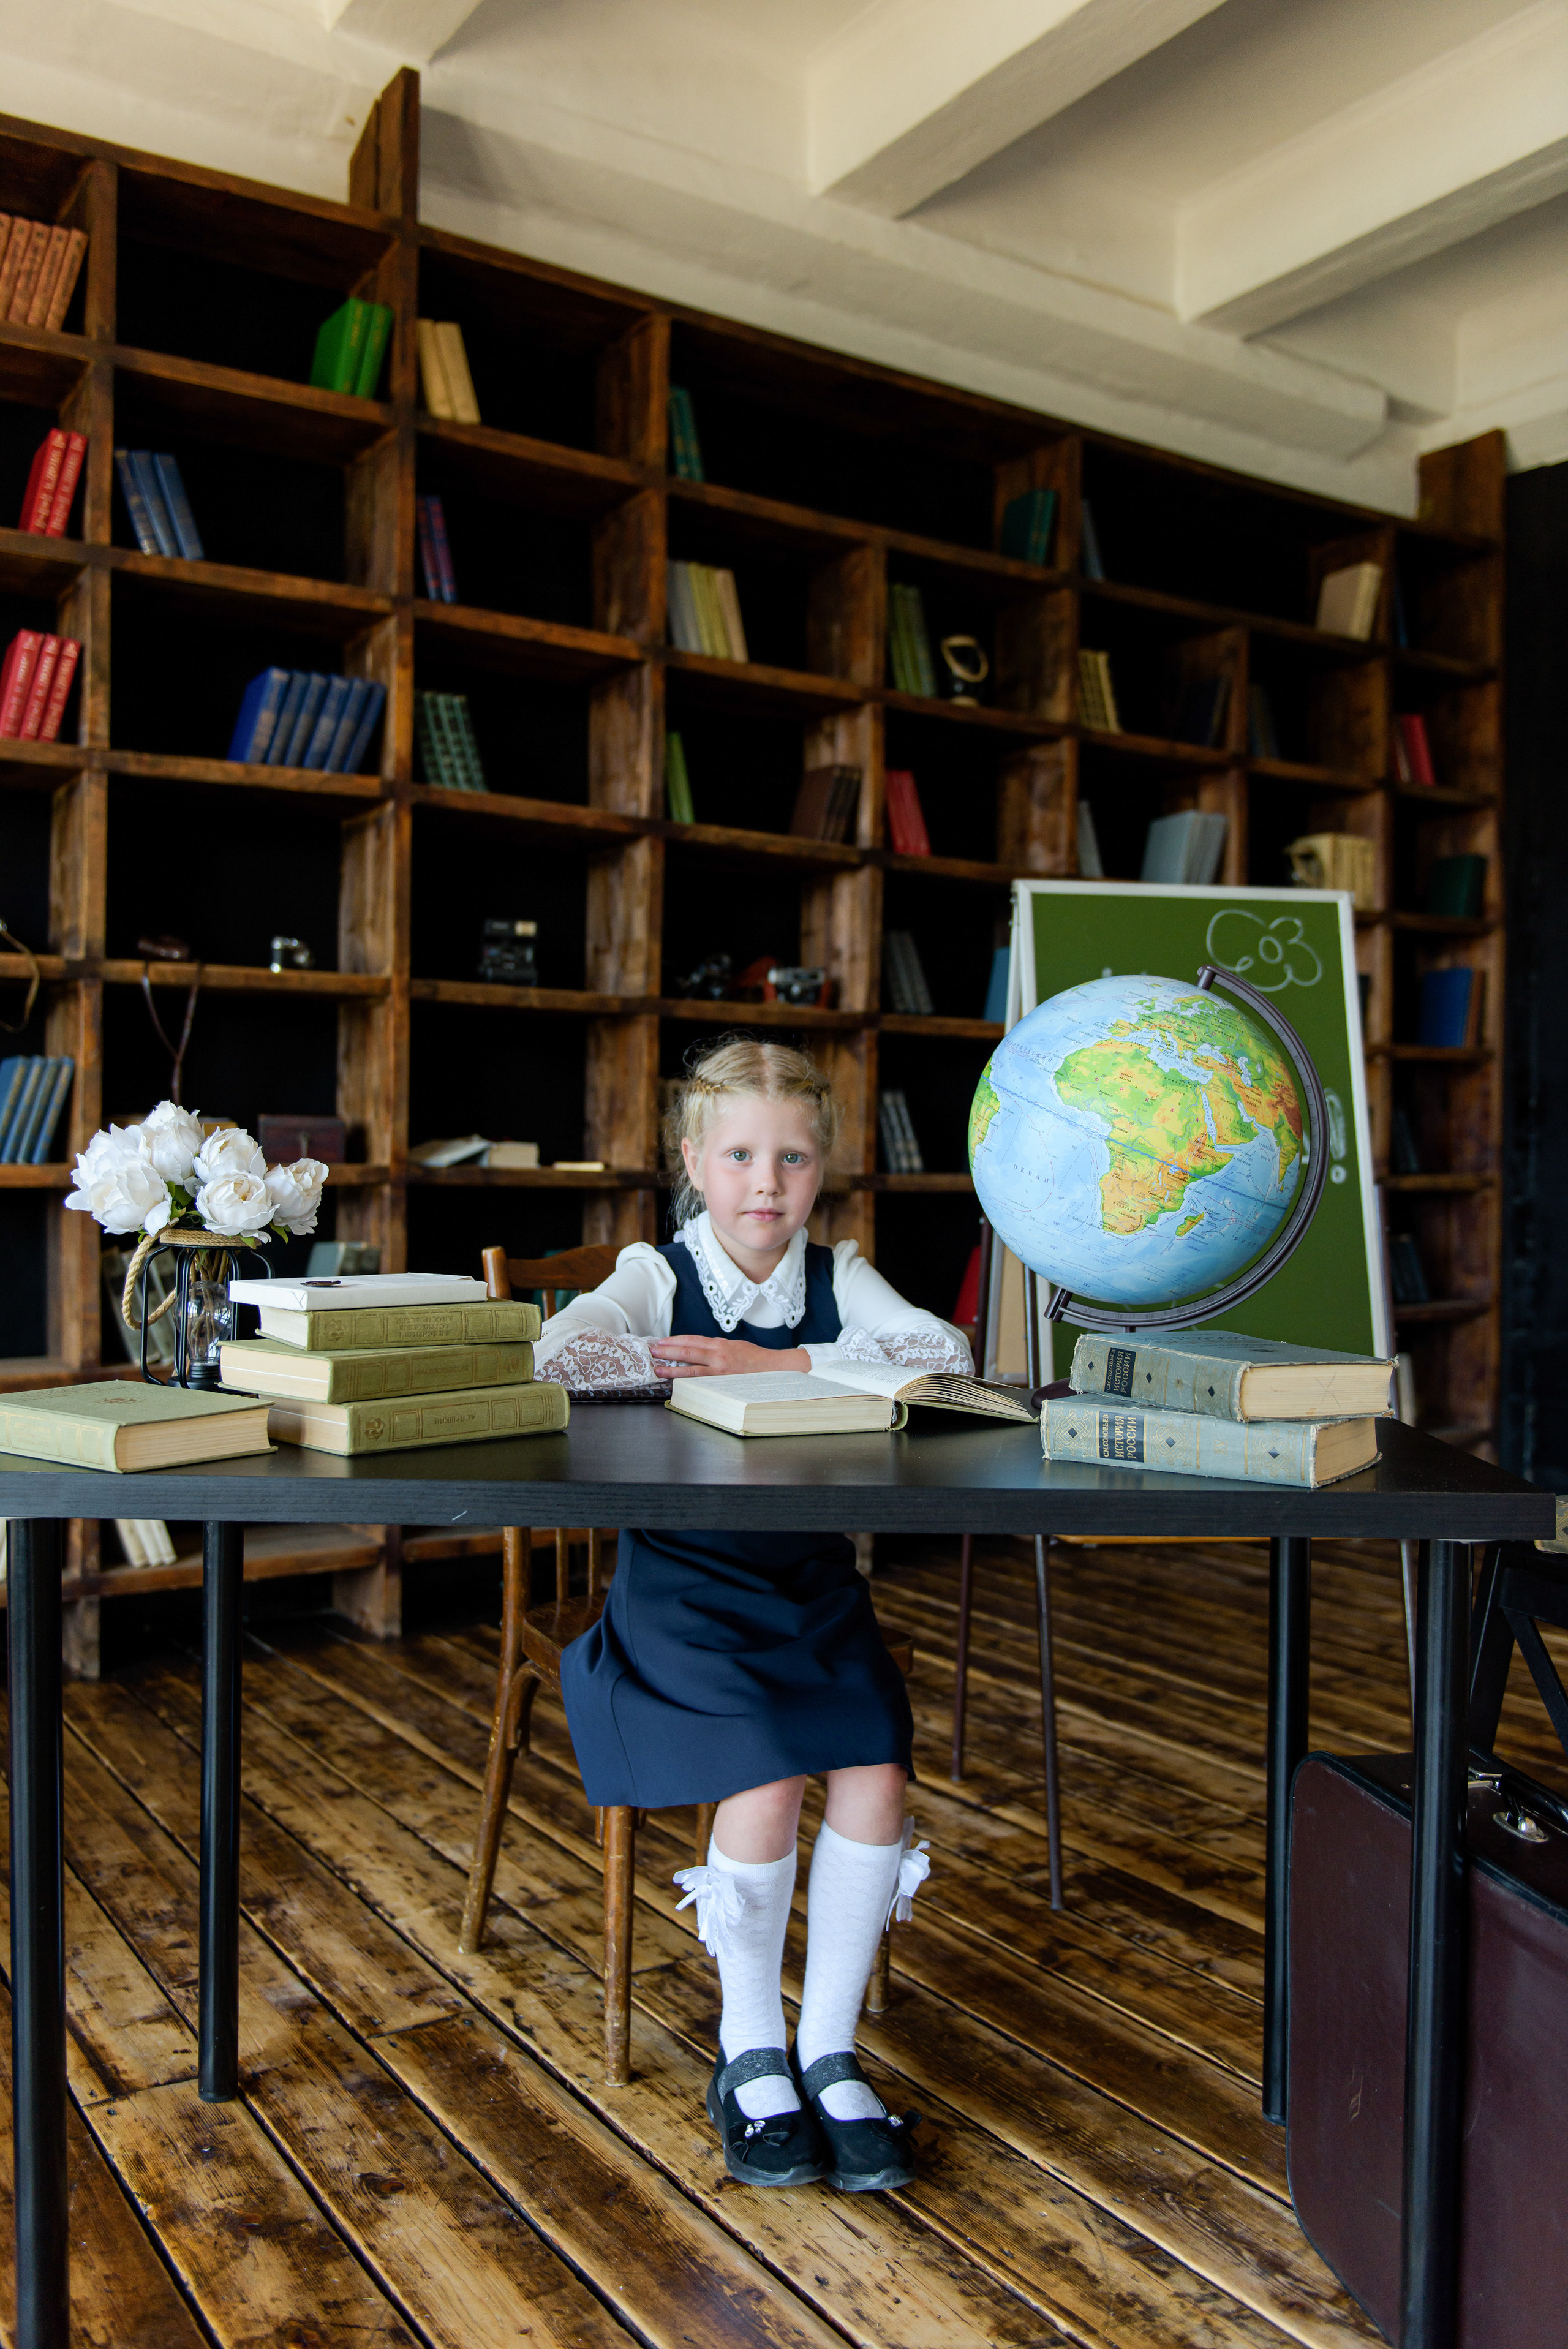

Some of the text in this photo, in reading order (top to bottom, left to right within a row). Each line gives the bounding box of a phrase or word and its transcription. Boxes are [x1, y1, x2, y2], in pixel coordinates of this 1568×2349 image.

[1013, 1164, 1049, 1184] ОКЕАН
[1112, 1201, 1136, 1213] Калахари
[1113, 1351, 1125, 1392] ИСТОРИЯ
[1120, 1352, 1132, 1393] РОССИИ
[1114, 1415, 1125, 1459] ИСТОРИЯ
[1126, 1416, 1137, 1460] РОССИИ
[1213, 1439, 1228, 1457] XV
